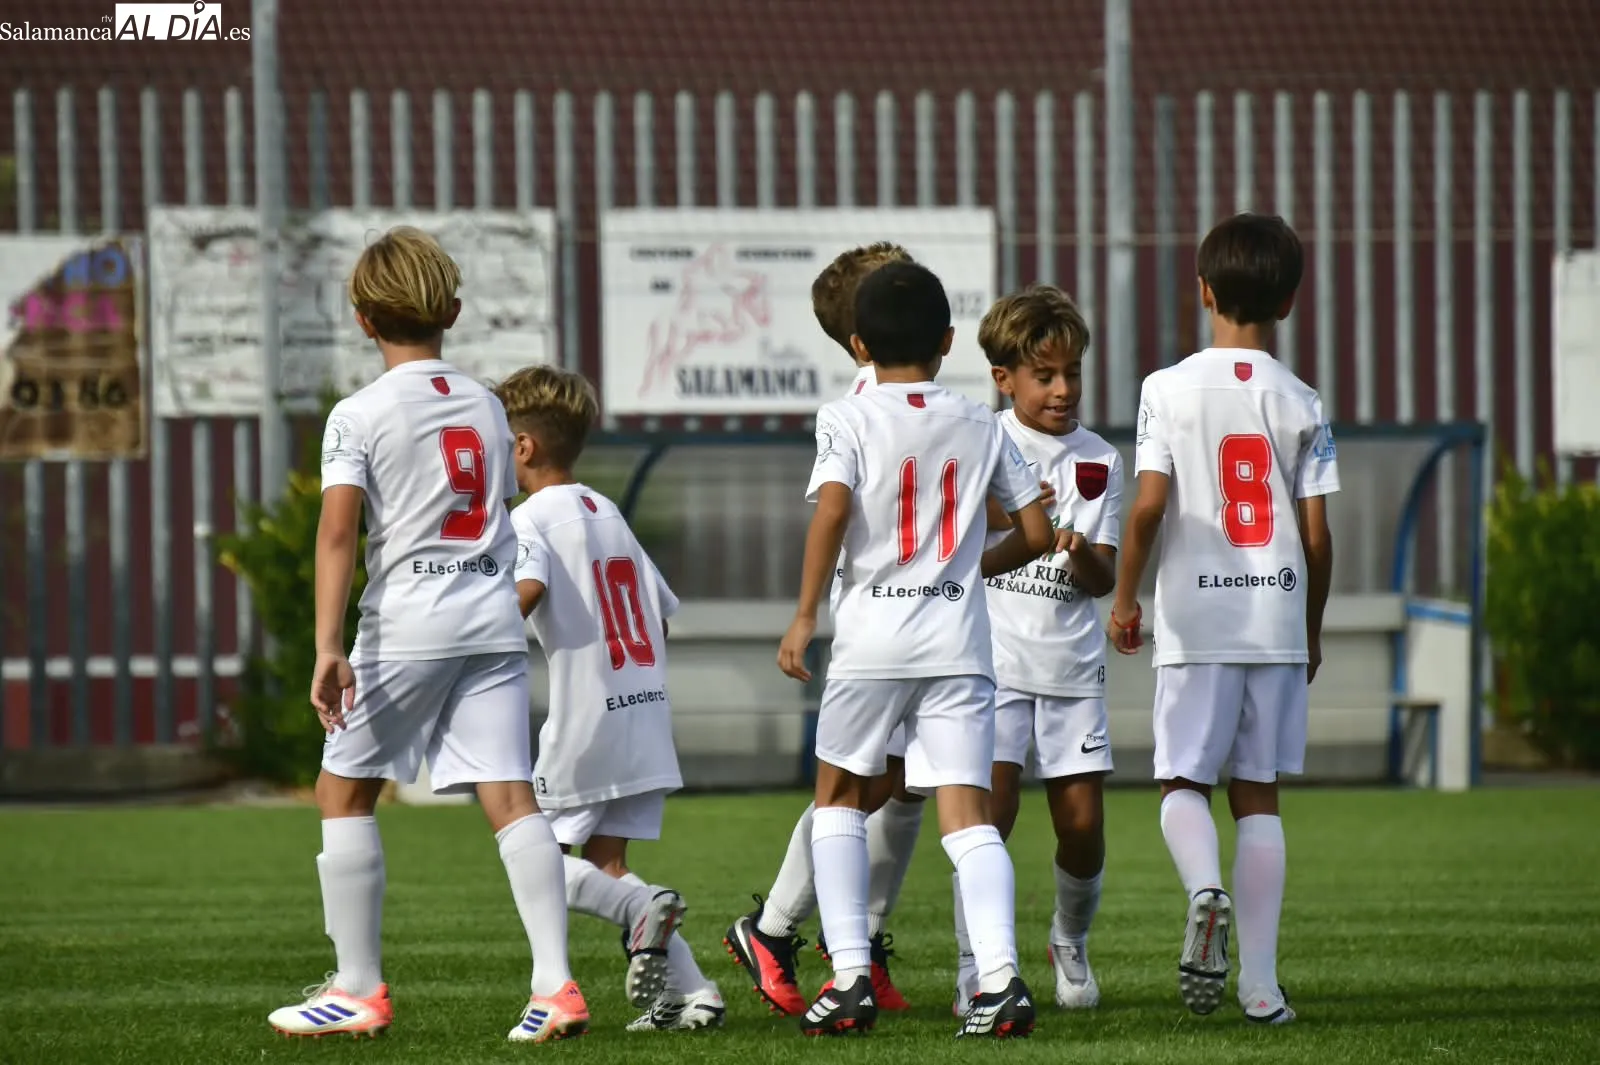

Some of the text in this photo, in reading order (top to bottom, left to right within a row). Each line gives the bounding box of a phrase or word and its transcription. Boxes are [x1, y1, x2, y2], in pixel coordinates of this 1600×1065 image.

[676, 363, 820, 397] SALAMANCA
[439, 426, 488, 540] 9
[896, 455, 958, 566] 11
[1218, 433, 1274, 548] 8
[592, 556, 656, 671] 10
[986, 577, 1005, 590] DE
[1198, 573, 1276, 588] E.Leclerc
[606, 689, 665, 711] E.Leclerc
